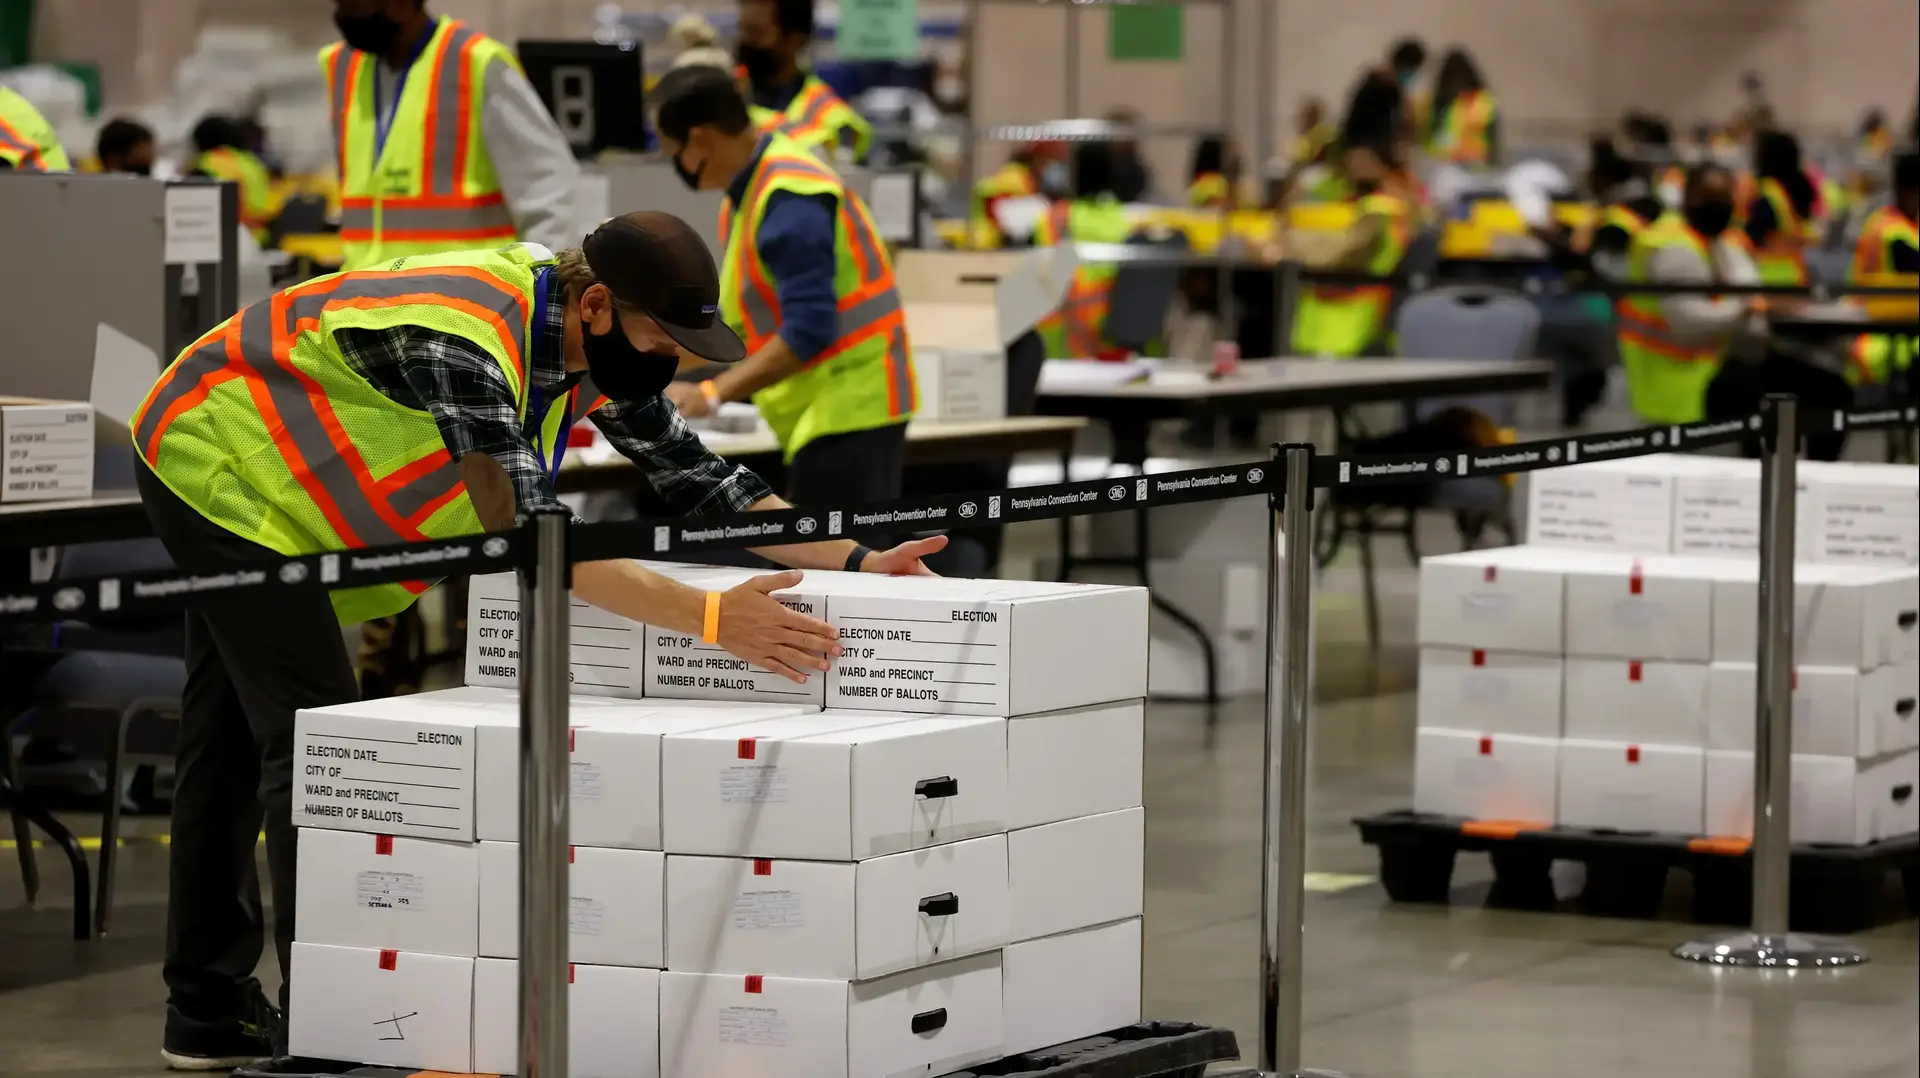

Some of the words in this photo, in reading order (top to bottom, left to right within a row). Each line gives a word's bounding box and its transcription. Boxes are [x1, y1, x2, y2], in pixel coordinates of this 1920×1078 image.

[1157, 478, 1190, 492] Pennsylvania
[1191, 476, 1219, 488] Convention
[1220, 473, 1238, 485] Center
[1011, 494, 1048, 510] Pennsylvania
[1048, 493, 1079, 506] Convention
[1080, 490, 1098, 502] Center
[853, 511, 892, 526] Pennsylvania
[893, 508, 926, 522] Convention
[927, 506, 948, 518] Center
[681, 526, 724, 542] Pennsylvania
[724, 523, 762, 538] Convention
[762, 522, 784, 534] Center
[780, 602, 812, 614] CTION
[952, 610, 998, 622] ELECTION
[479, 628, 499, 638] CITY
[502, 629, 514, 639] OF
[840, 628, 884, 640] ELECTION
[887, 630, 911, 642] DATE
[657, 636, 678, 648] CITY
[680, 637, 693, 648] OF
[479, 646, 506, 658] WARD
[508, 650, 520, 659] an
[862, 648, 875, 658] OF
[657, 655, 684, 668] WARD
[687, 658, 702, 668] and
[706, 659, 749, 671] PRECINCT
[478, 665, 516, 678] NUMBER
[839, 666, 866, 678] WARD
[869, 668, 886, 679] and
[888, 669, 934, 681] PRECINCT
[657, 675, 695, 687] NUMBER
[698, 677, 711, 688] OF
[714, 678, 754, 690] BALLOTS
[839, 686, 878, 698] NUMBER
[881, 687, 893, 698] OF
[896, 689, 938, 700] BALLOTS
[417, 732, 462, 746] ELECTION
[306, 745, 350, 759] ELECTION
[353, 749, 378, 762] DATE
[306, 765, 325, 777] CITY
[328, 767, 341, 778] OF
[305, 784, 333, 796] WARD
[335, 788, 350, 798] and
[354, 789, 399, 803] PRECINCT
[305, 804, 343, 817] NUMBER
[346, 808, 359, 818] OF
[362, 809, 403, 823] BALLOTS
